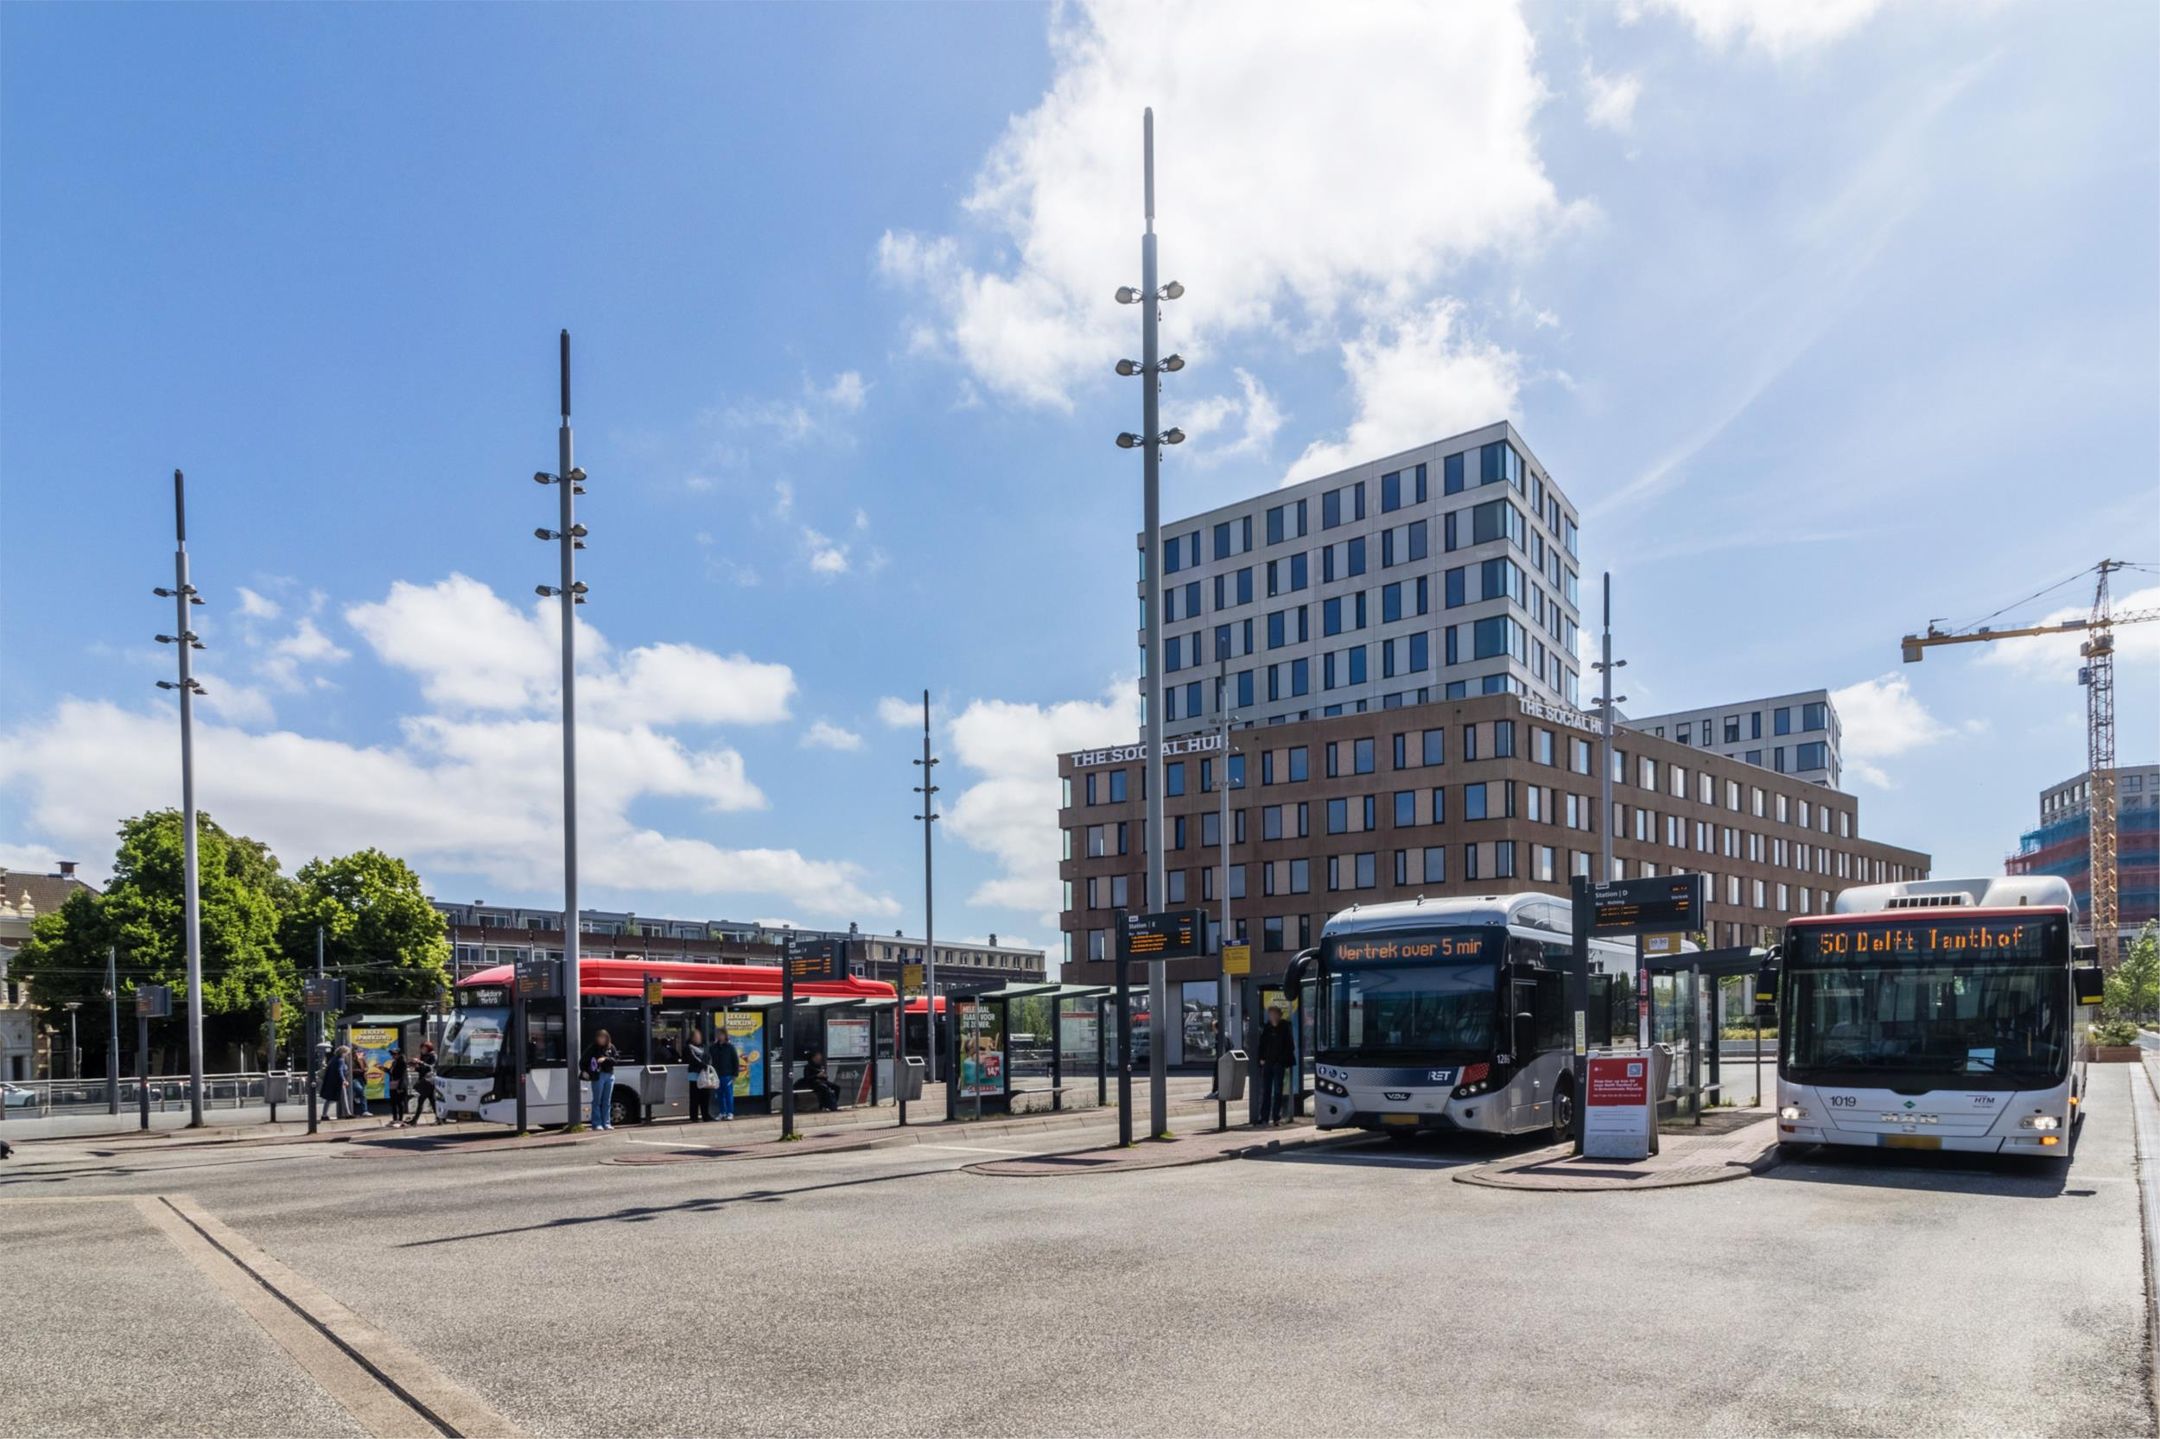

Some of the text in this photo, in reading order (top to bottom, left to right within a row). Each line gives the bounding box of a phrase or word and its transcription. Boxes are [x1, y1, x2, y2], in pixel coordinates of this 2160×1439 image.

[1519, 698, 1613, 735] THE SOCIAL HU
[1072, 751, 1106, 767] THE
[1112, 741, 1183, 762] SOCAL
[1857, 930, 1914, 952] Delft
[1929, 926, 2024, 949] Tanthof
[1338, 942, 1398, 960] Vertrek
[1402, 943, 1437, 957] over
[1442, 938, 1452, 955] 5
[962, 1005, 990, 1013] HELEAAL
[980, 1013, 995, 1021] VOOR
[1428, 1071, 1451, 1081] RET
[1830, 1095, 1857, 1107] 1019
[1974, 1095, 1995, 1104] HTM
[1880, 1113, 1939, 1124] MAN
